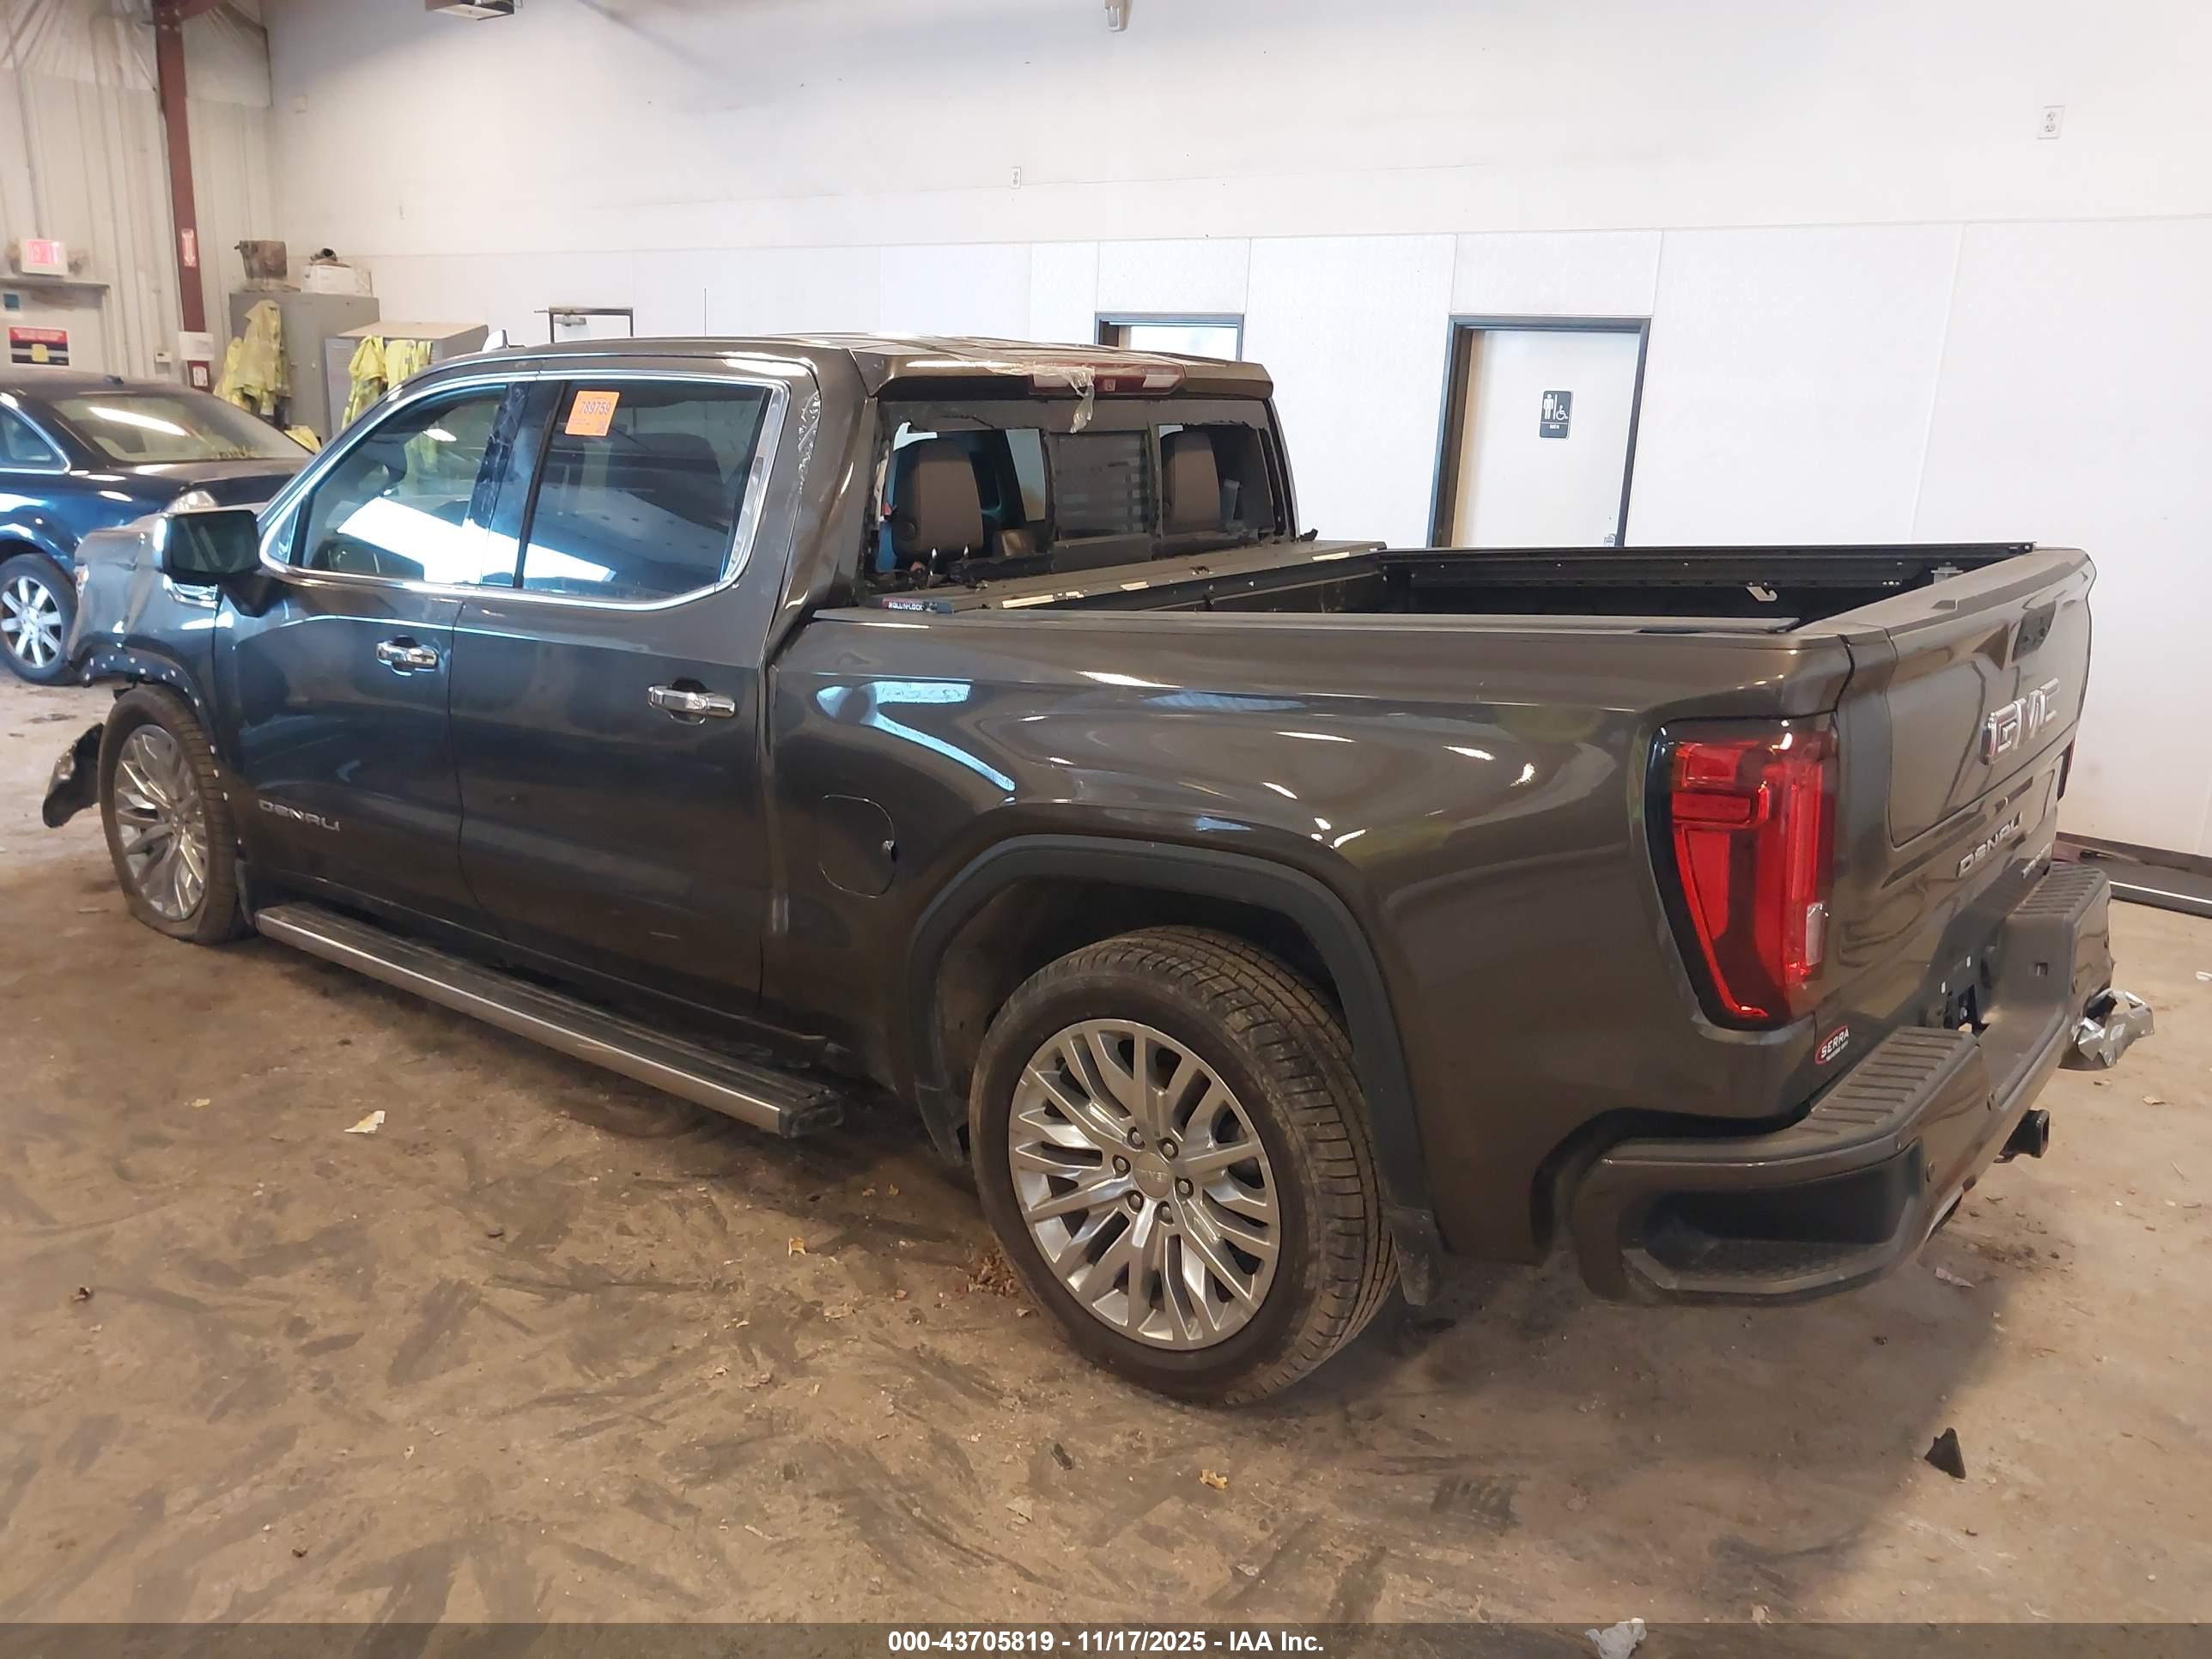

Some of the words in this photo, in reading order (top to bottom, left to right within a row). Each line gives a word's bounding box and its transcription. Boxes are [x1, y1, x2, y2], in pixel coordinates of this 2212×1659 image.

[1984, 678, 2060, 761] GMC
[258, 799, 341, 832] DENALI
[1957, 811, 2023, 878] DENALI
[1820, 1027, 1850, 1059] SERRA
